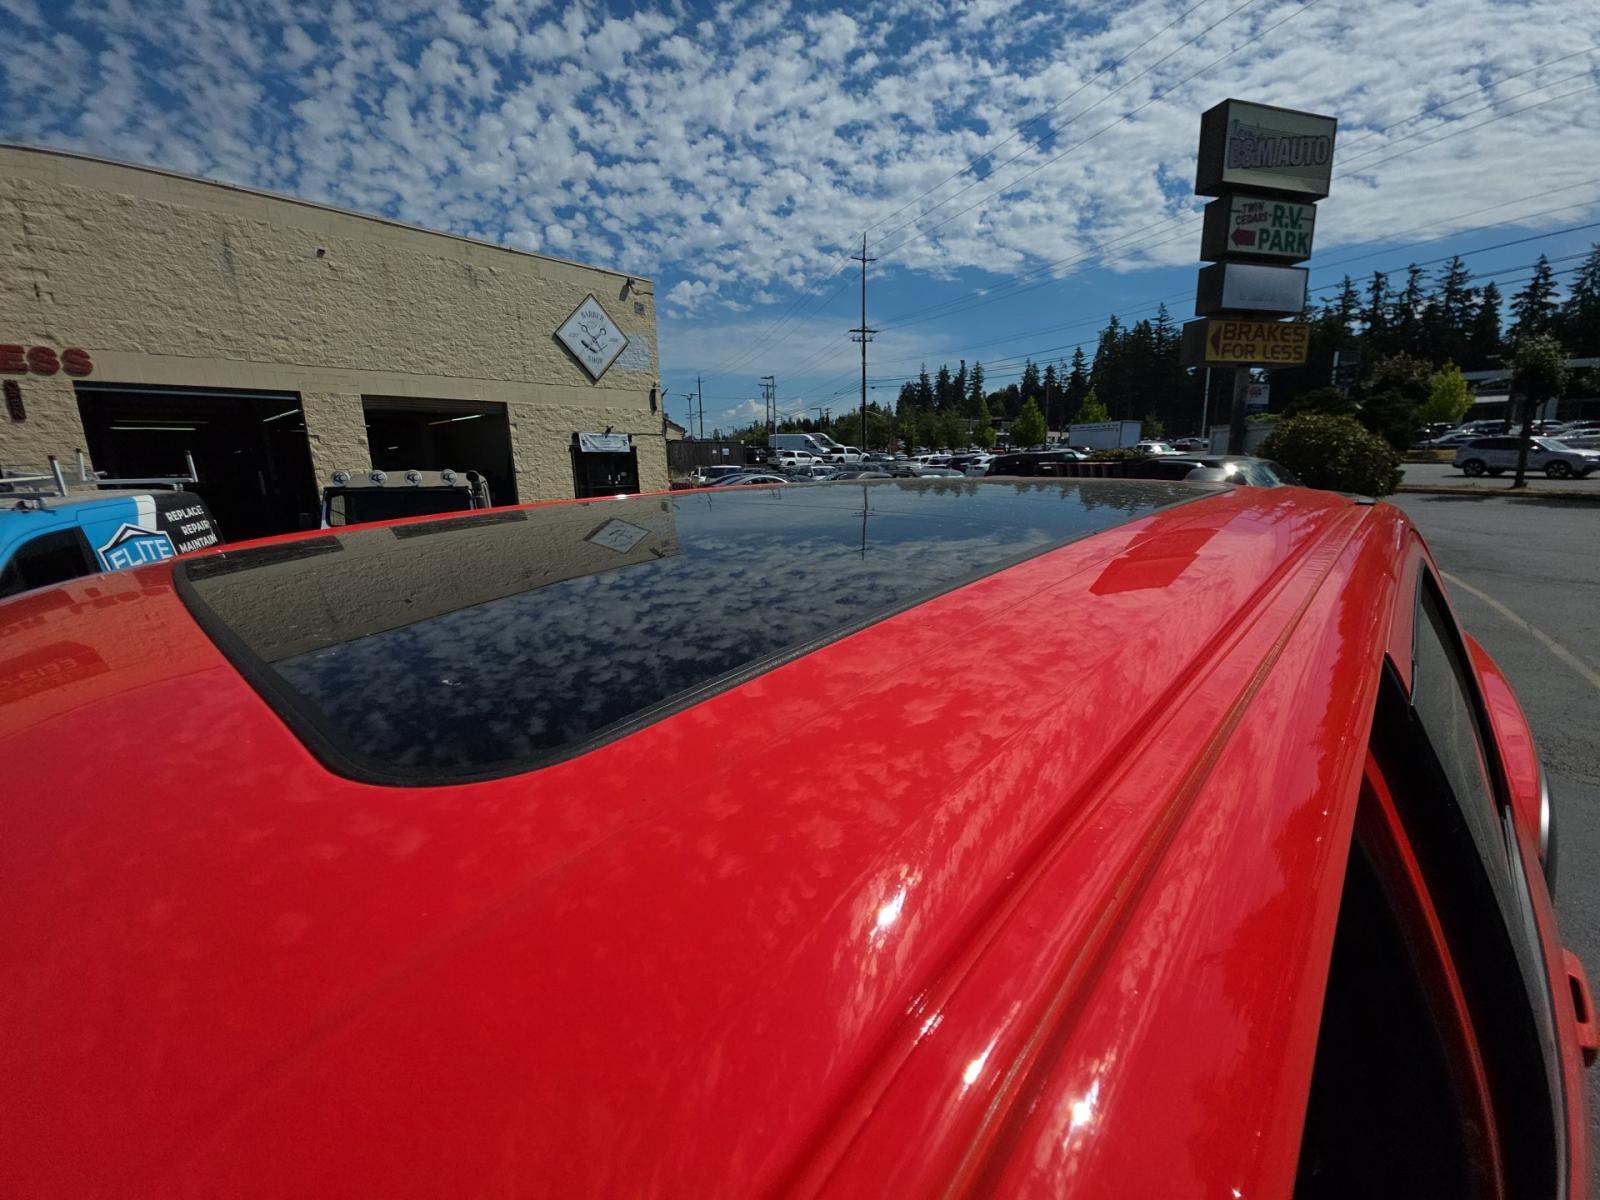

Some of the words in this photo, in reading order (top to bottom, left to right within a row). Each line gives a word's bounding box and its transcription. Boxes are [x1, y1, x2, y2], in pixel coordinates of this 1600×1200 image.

[1272, 203, 1303, 229] R.V.
[1257, 227, 1309, 255] PARK
[1223, 322, 1307, 343] BRAKES
[1221, 342, 1256, 359] FOR
[1263, 343, 1304, 361] LESS
[165, 504, 204, 522] REPLACE
[180, 520, 211, 536] REPAIR
[178, 533, 218, 553] MAINTAIN
